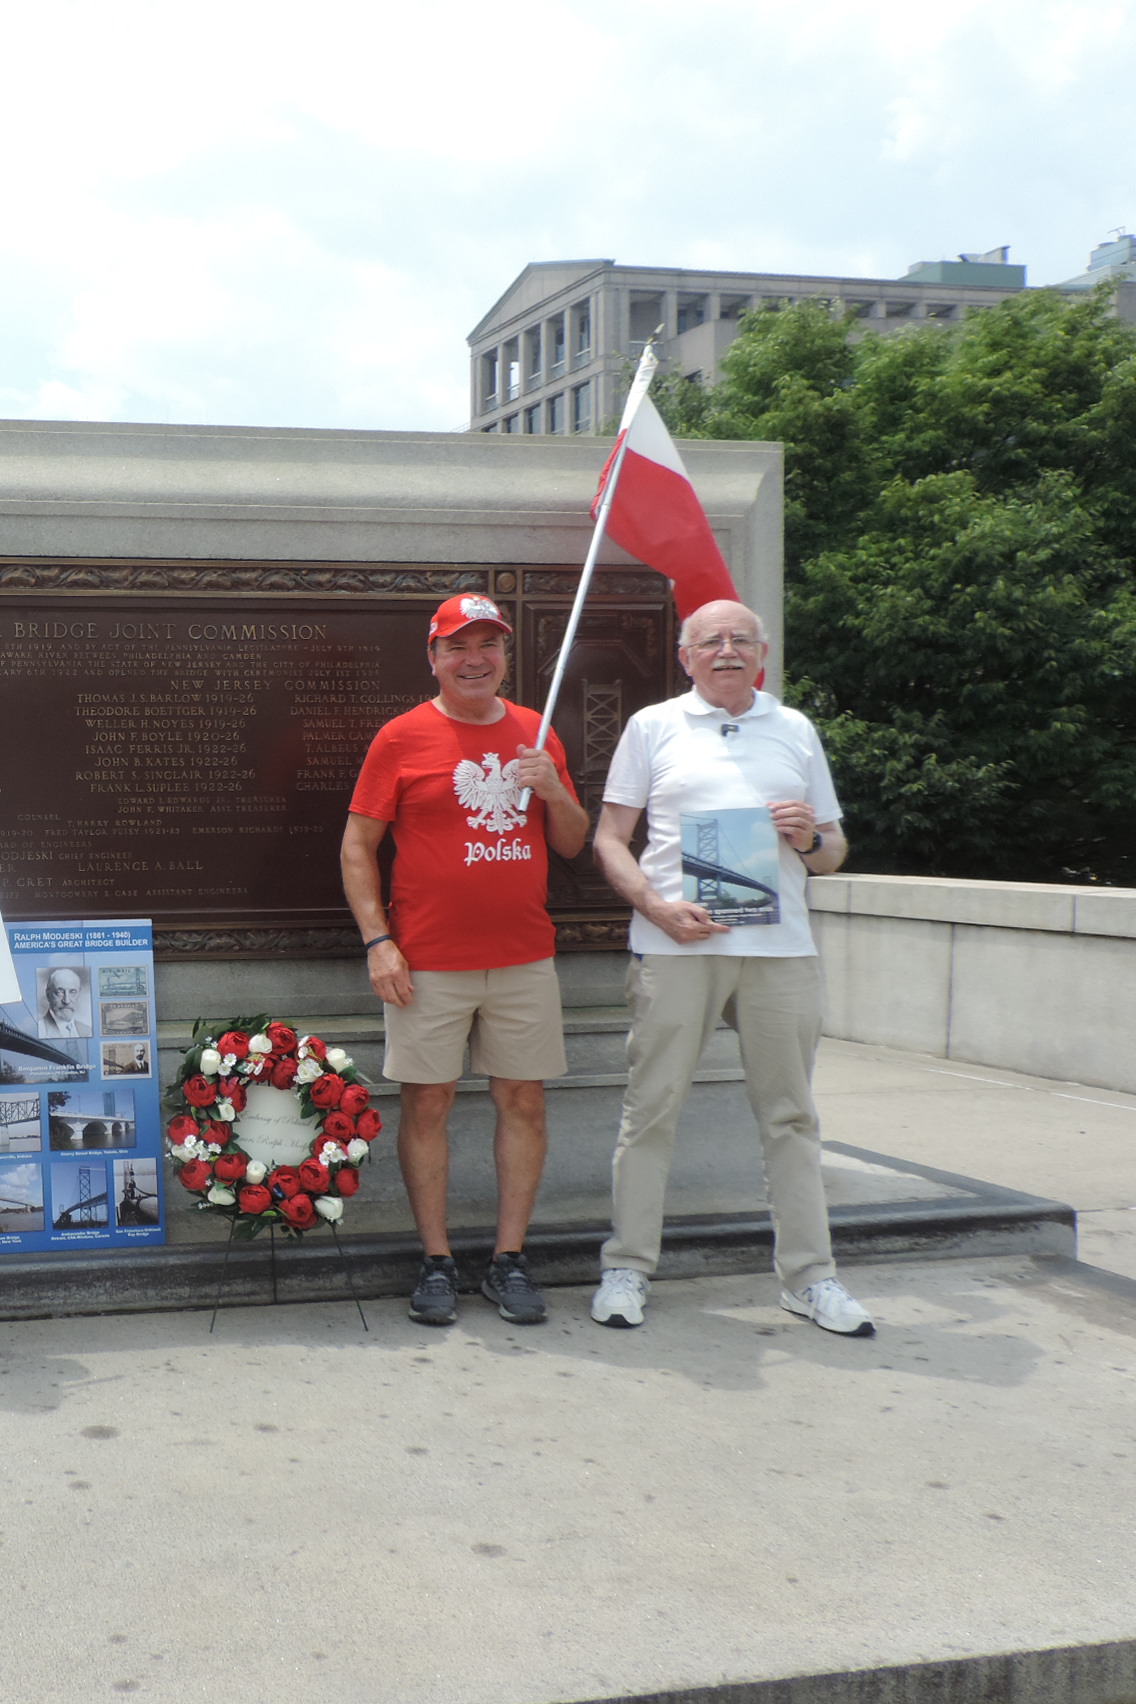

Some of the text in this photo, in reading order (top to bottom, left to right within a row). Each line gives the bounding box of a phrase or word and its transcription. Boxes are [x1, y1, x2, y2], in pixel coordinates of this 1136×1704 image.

[14, 621, 100, 639] BRIDGE
[109, 622, 178, 640] JOINT
[188, 623, 328, 642] COMMISSION
[123, 652, 192, 660] PHILADELPHIA
[223, 653, 262, 661] CAMDEN
[11, 660, 83, 668] PENNSYLVANIA
[88, 660, 106, 668] THE
[186, 661, 221, 669] JERSEY
[252, 661, 268, 669] THE
[315, 662, 380, 670] PHILADELPHIA
[26, 669, 45, 677] 6TH
[84, 669, 102, 677] AND
[170, 680, 381, 691] NEW JERSEY COMMISSION
[77, 694, 255, 703] THOMAS 1919-26
[294, 694, 347, 704] RICHARD
[74, 706, 258, 717] THEODORE BOETTGER 1919-26
[290, 706, 331, 716] DANIEL
[84, 720, 246, 729] WELLER 1919-26
[303, 719, 346, 728] SAMUEL
[93, 732, 126, 742] JOHN
[141, 732, 184, 742] BOYLE
[187, 732, 240, 742] 1920-26
[303, 732, 346, 741] PALMER
[84, 745, 123, 754] ISAAC
[128, 745, 174, 754] FERRIS
[94, 758, 238, 768] JOHN 1922-26
[306, 757, 353, 766] SAMUEL
[74, 771, 125, 781] ROBERT
[144, 771, 203, 780] SINCLAIR
[207, 770, 257, 780] 1922-26
[296, 769, 336, 779] FRANK
[89, 783, 243, 793] FRANK 1922-26
[295, 782, 350, 792] CHARLES
[115, 819, 163, 828] ROWLAND
[21, 841, 33, 849] OF
[40, 840, 93, 849] ENGINEERS
[58, 852, 84, 860] CHIEF
[89, 852, 134, 860] ENGINEER
[463, 837, 532, 867] Polska
[78, 860, 204, 872] LAURENCE BALL
[16, 877, 116, 888] CRET ARCHITECT
[14, 931, 131, 941] RALPH MODJESKI (1861 1940)
[14, 938, 149, 949] AMERICA'S GREAT BRIDGE BUILDER
[18, 1063, 97, 1073] Benjamin Franklin Bridge
